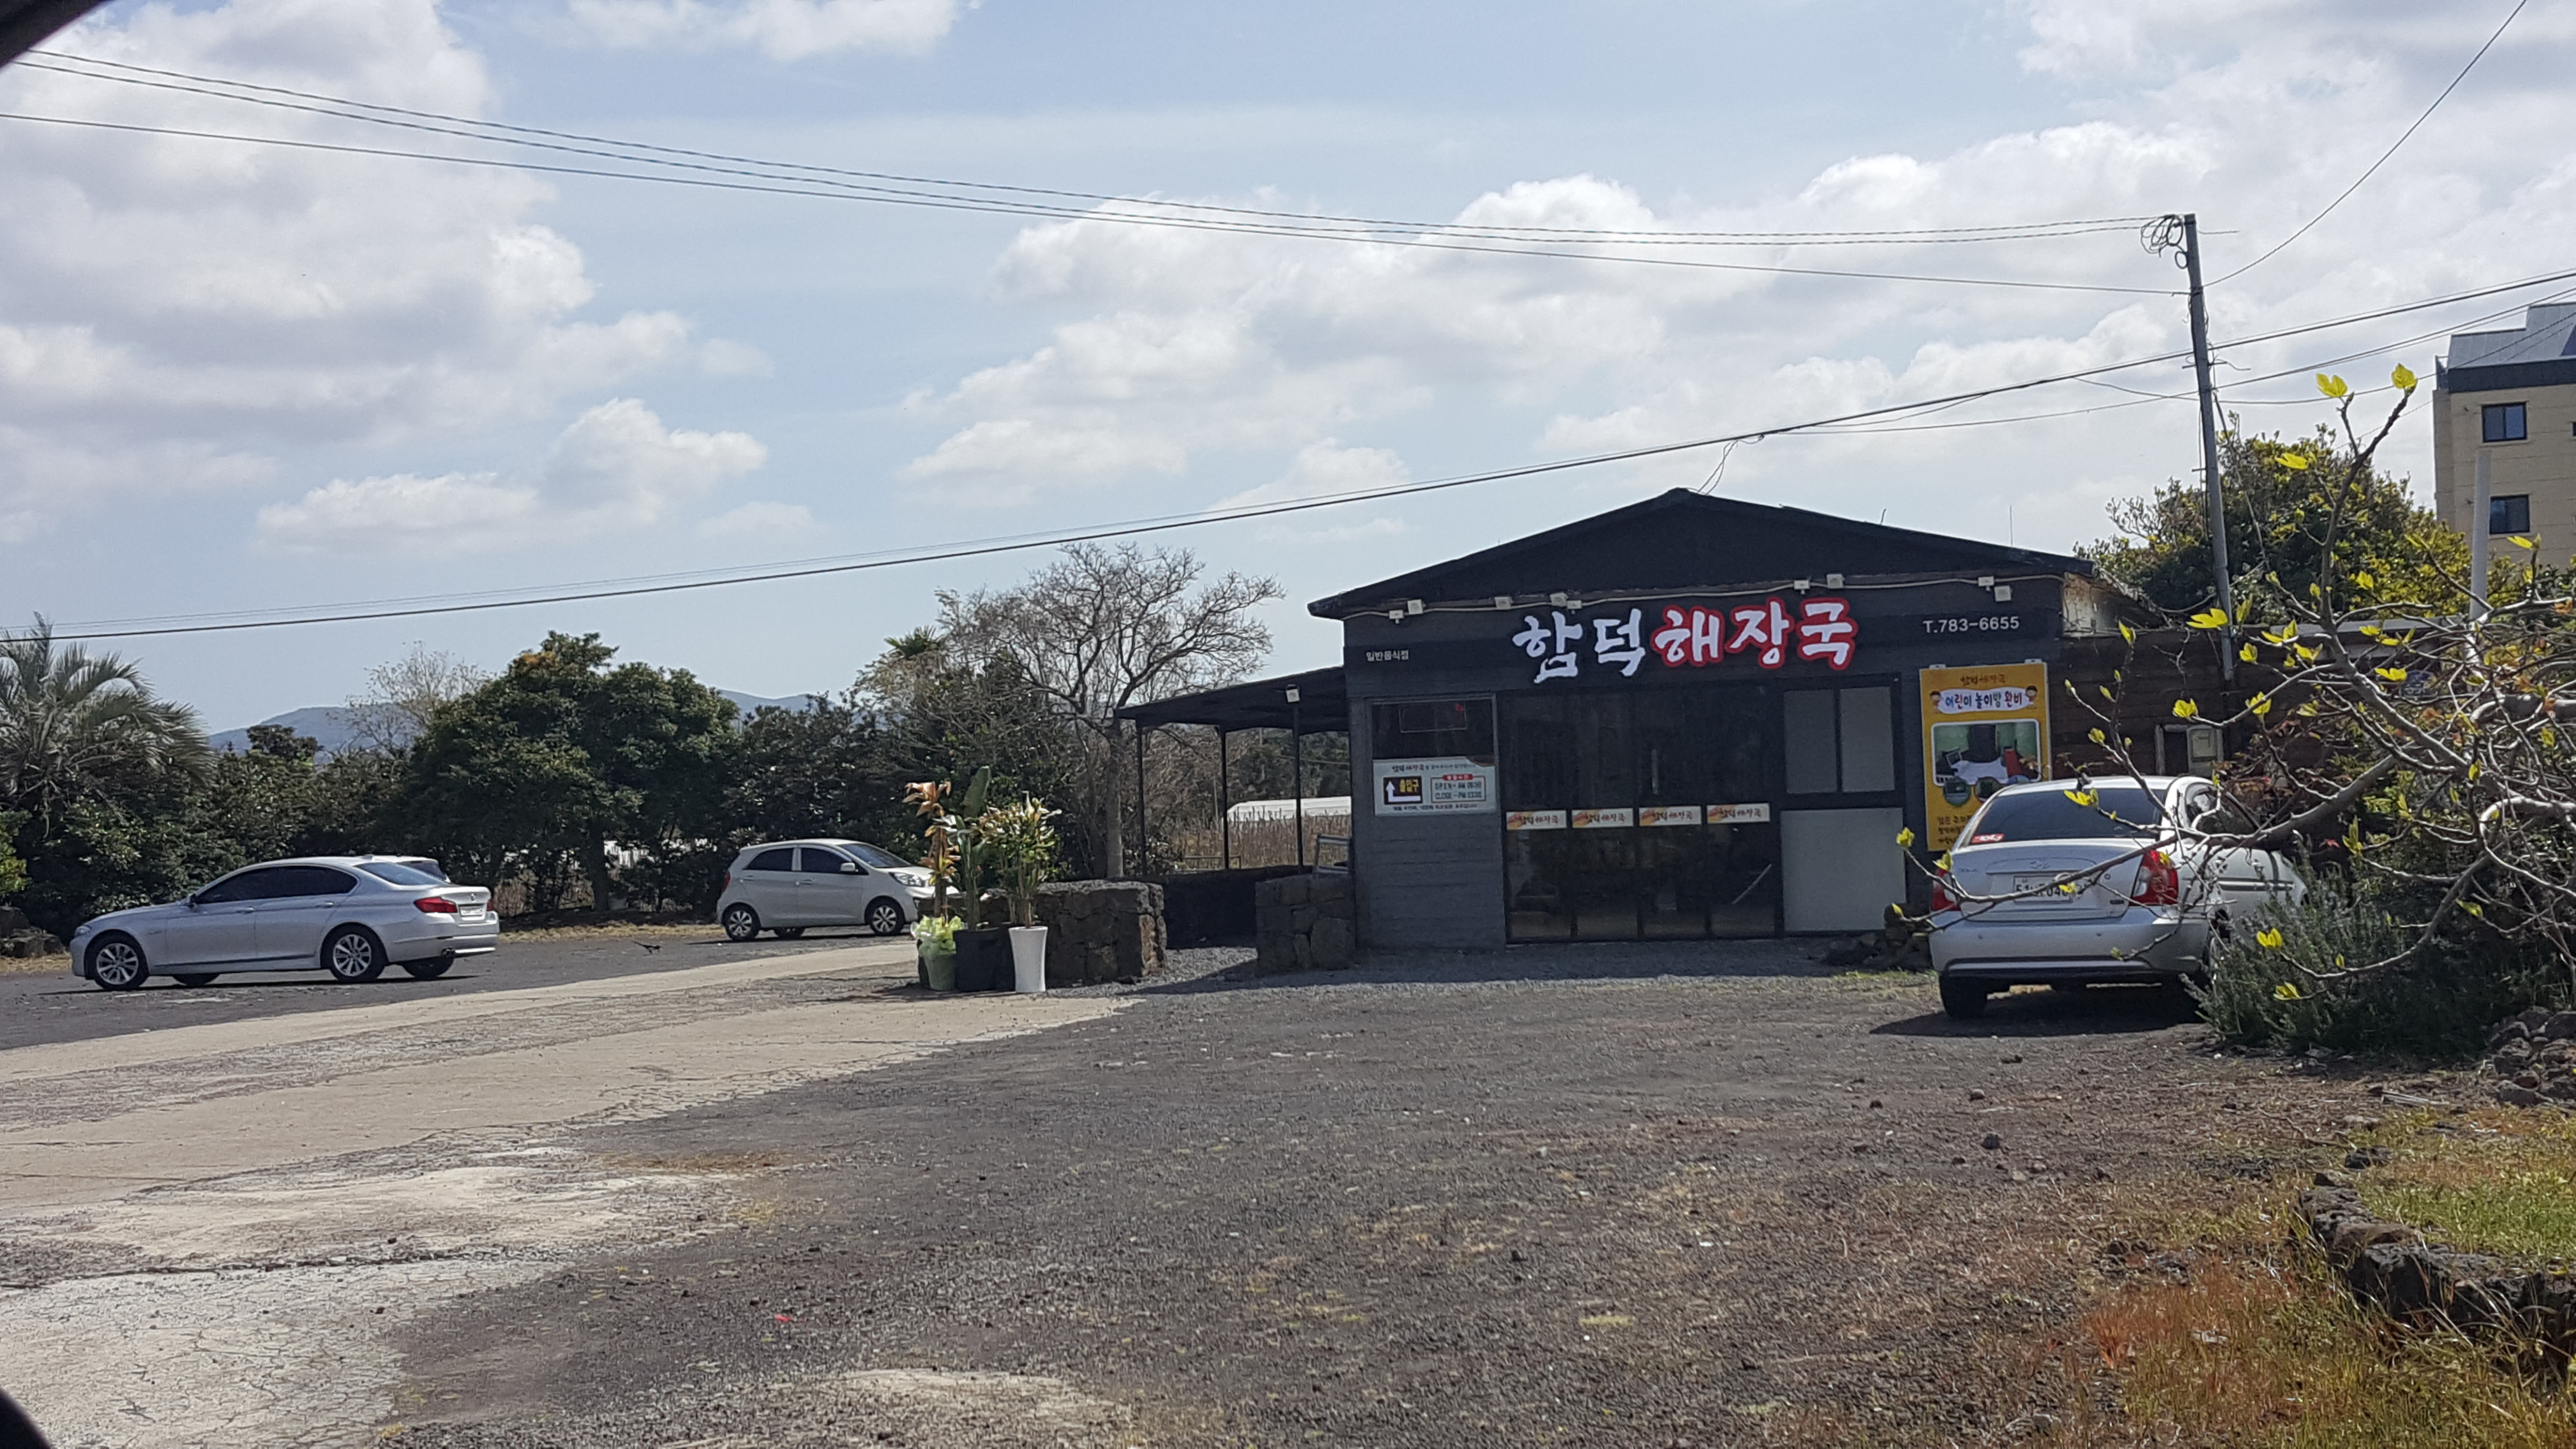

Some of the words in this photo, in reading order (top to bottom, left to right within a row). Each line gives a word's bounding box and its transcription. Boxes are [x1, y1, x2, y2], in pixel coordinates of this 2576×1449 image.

[1922, 616, 2019, 633] T.783-6655
[1366, 649, 1409, 661] 일반음식점
[1945, 693, 1972, 709] 어린이
[1975, 692, 2001, 709] 놀이방
[2005, 690, 2022, 708] 완비
